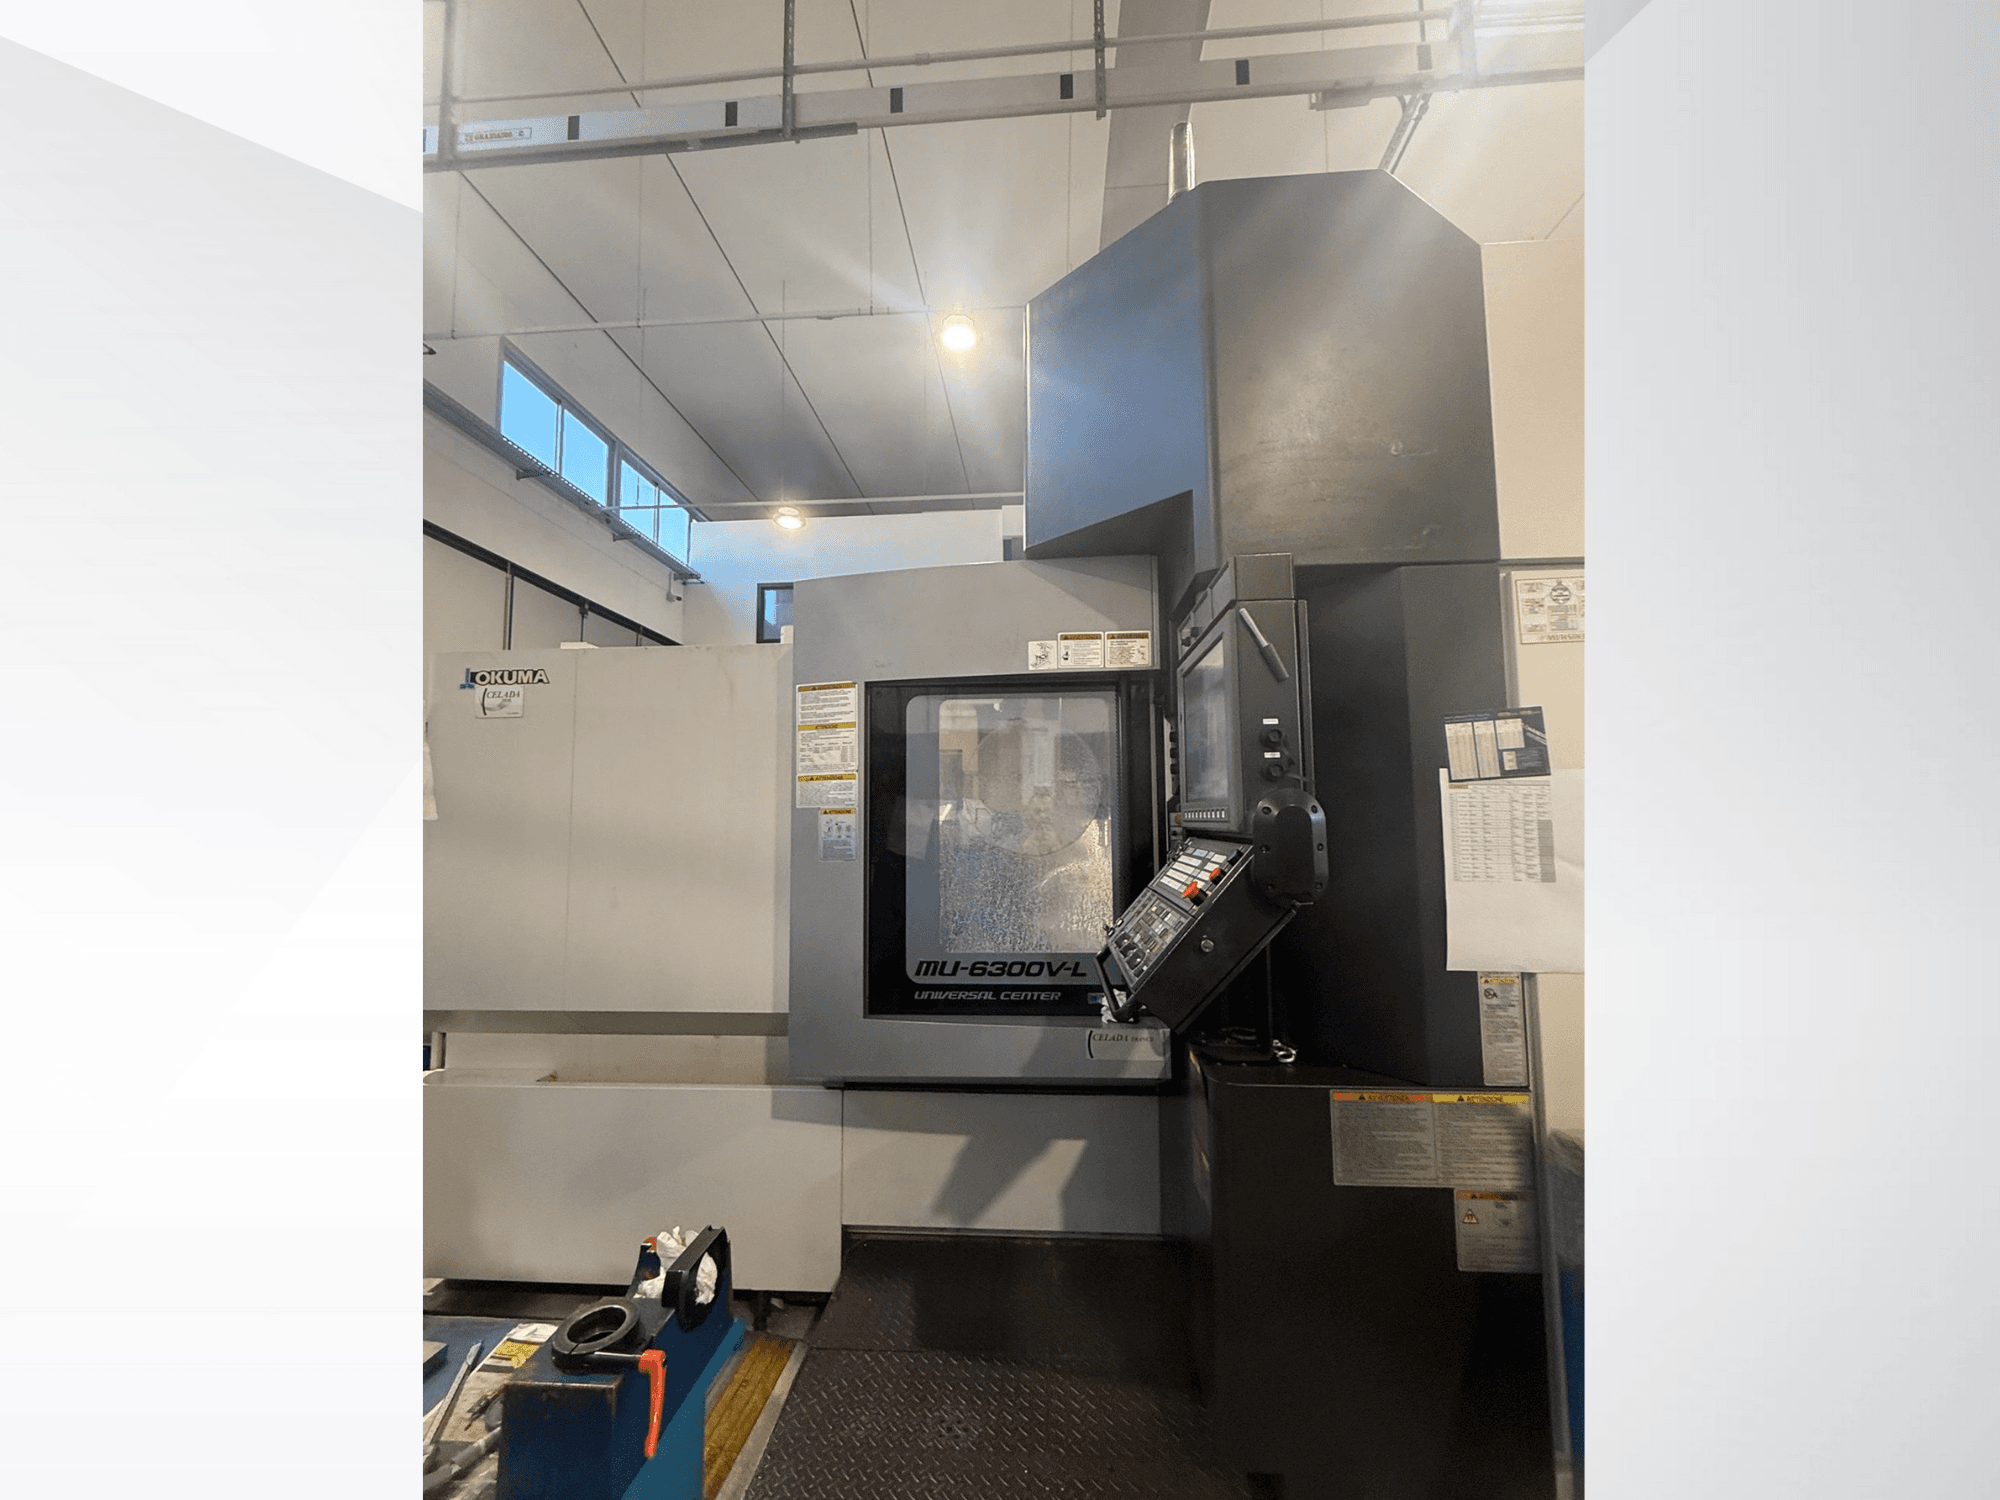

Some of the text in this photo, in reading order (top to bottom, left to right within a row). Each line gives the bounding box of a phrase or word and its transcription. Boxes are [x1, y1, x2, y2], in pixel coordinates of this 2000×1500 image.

[475, 669, 550, 686] OKUMA
[486, 690, 520, 699] CELADA
[914, 960, 1087, 977] MU-6300V-L
[914, 991, 1061, 1000] UNIVERSAL CENTER
[1093, 1034, 1128, 1042] CELADA
